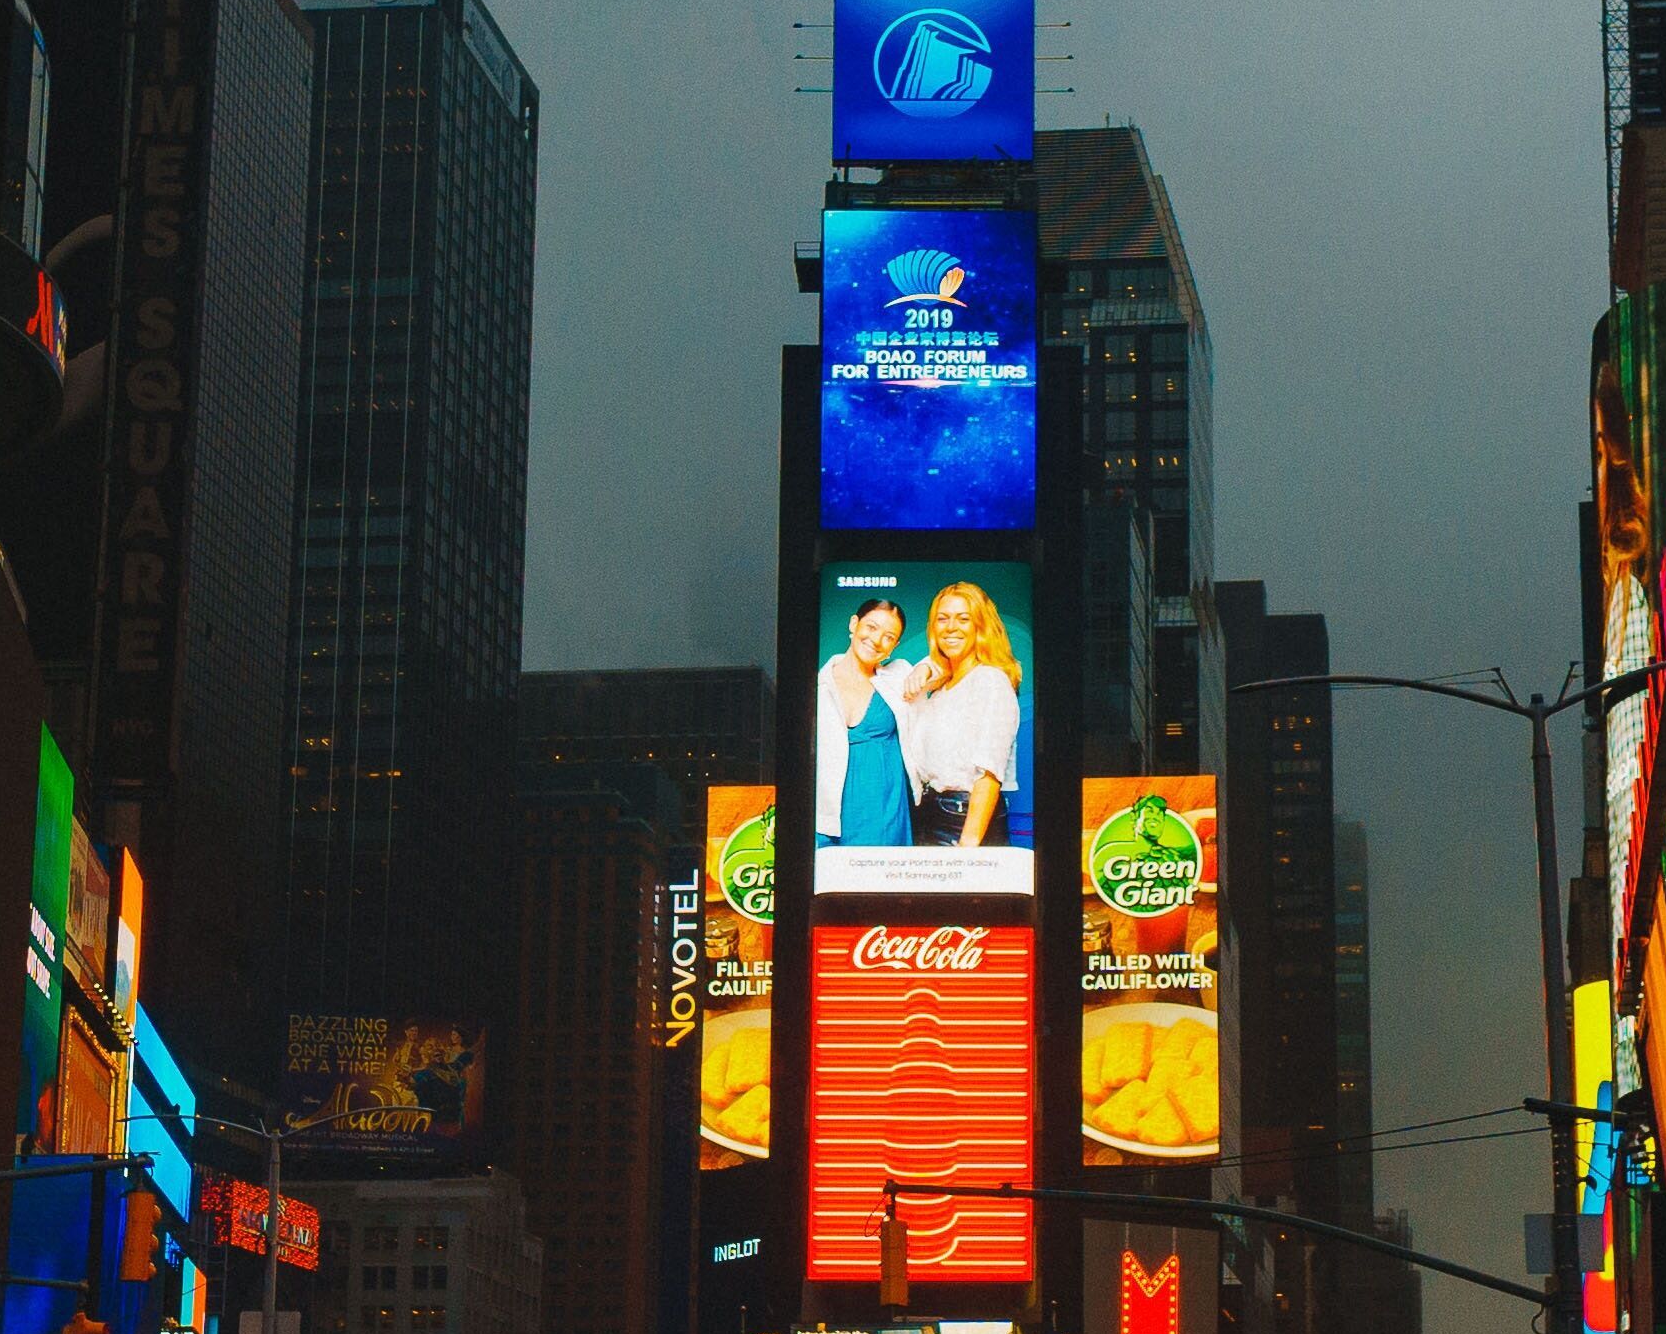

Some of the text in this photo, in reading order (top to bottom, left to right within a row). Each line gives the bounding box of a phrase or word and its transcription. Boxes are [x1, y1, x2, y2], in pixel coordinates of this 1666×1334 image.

[904, 309, 954, 329] 2019
[865, 350, 987, 364] BOAO FORUM
[832, 364, 1028, 380] FOR ENTREPRENEURS
[117, 297, 183, 675] SQUARE
[837, 576, 898, 587] SAMSUNG
[946, 858, 966, 868] with
[1103, 855, 1196, 881] Green
[904, 870, 944, 883] Samsung
[1113, 880, 1199, 907] Giant
[853, 925, 990, 972] Coca-Cola
[665, 868, 700, 1048] NOVOTEL
[1088, 953, 1206, 971] FILLED WITH
[1081, 972, 1214, 991] CAULIFLOWER
[288, 1014, 388, 1031] DAZZLING
[288, 1028, 388, 1045] BROADWAY
[288, 1043, 388, 1060] ONE WISH
[288, 1058, 314, 1073] AT
[317, 1059, 332, 1073] A
[713, 1238, 762, 1262] INGLOT
